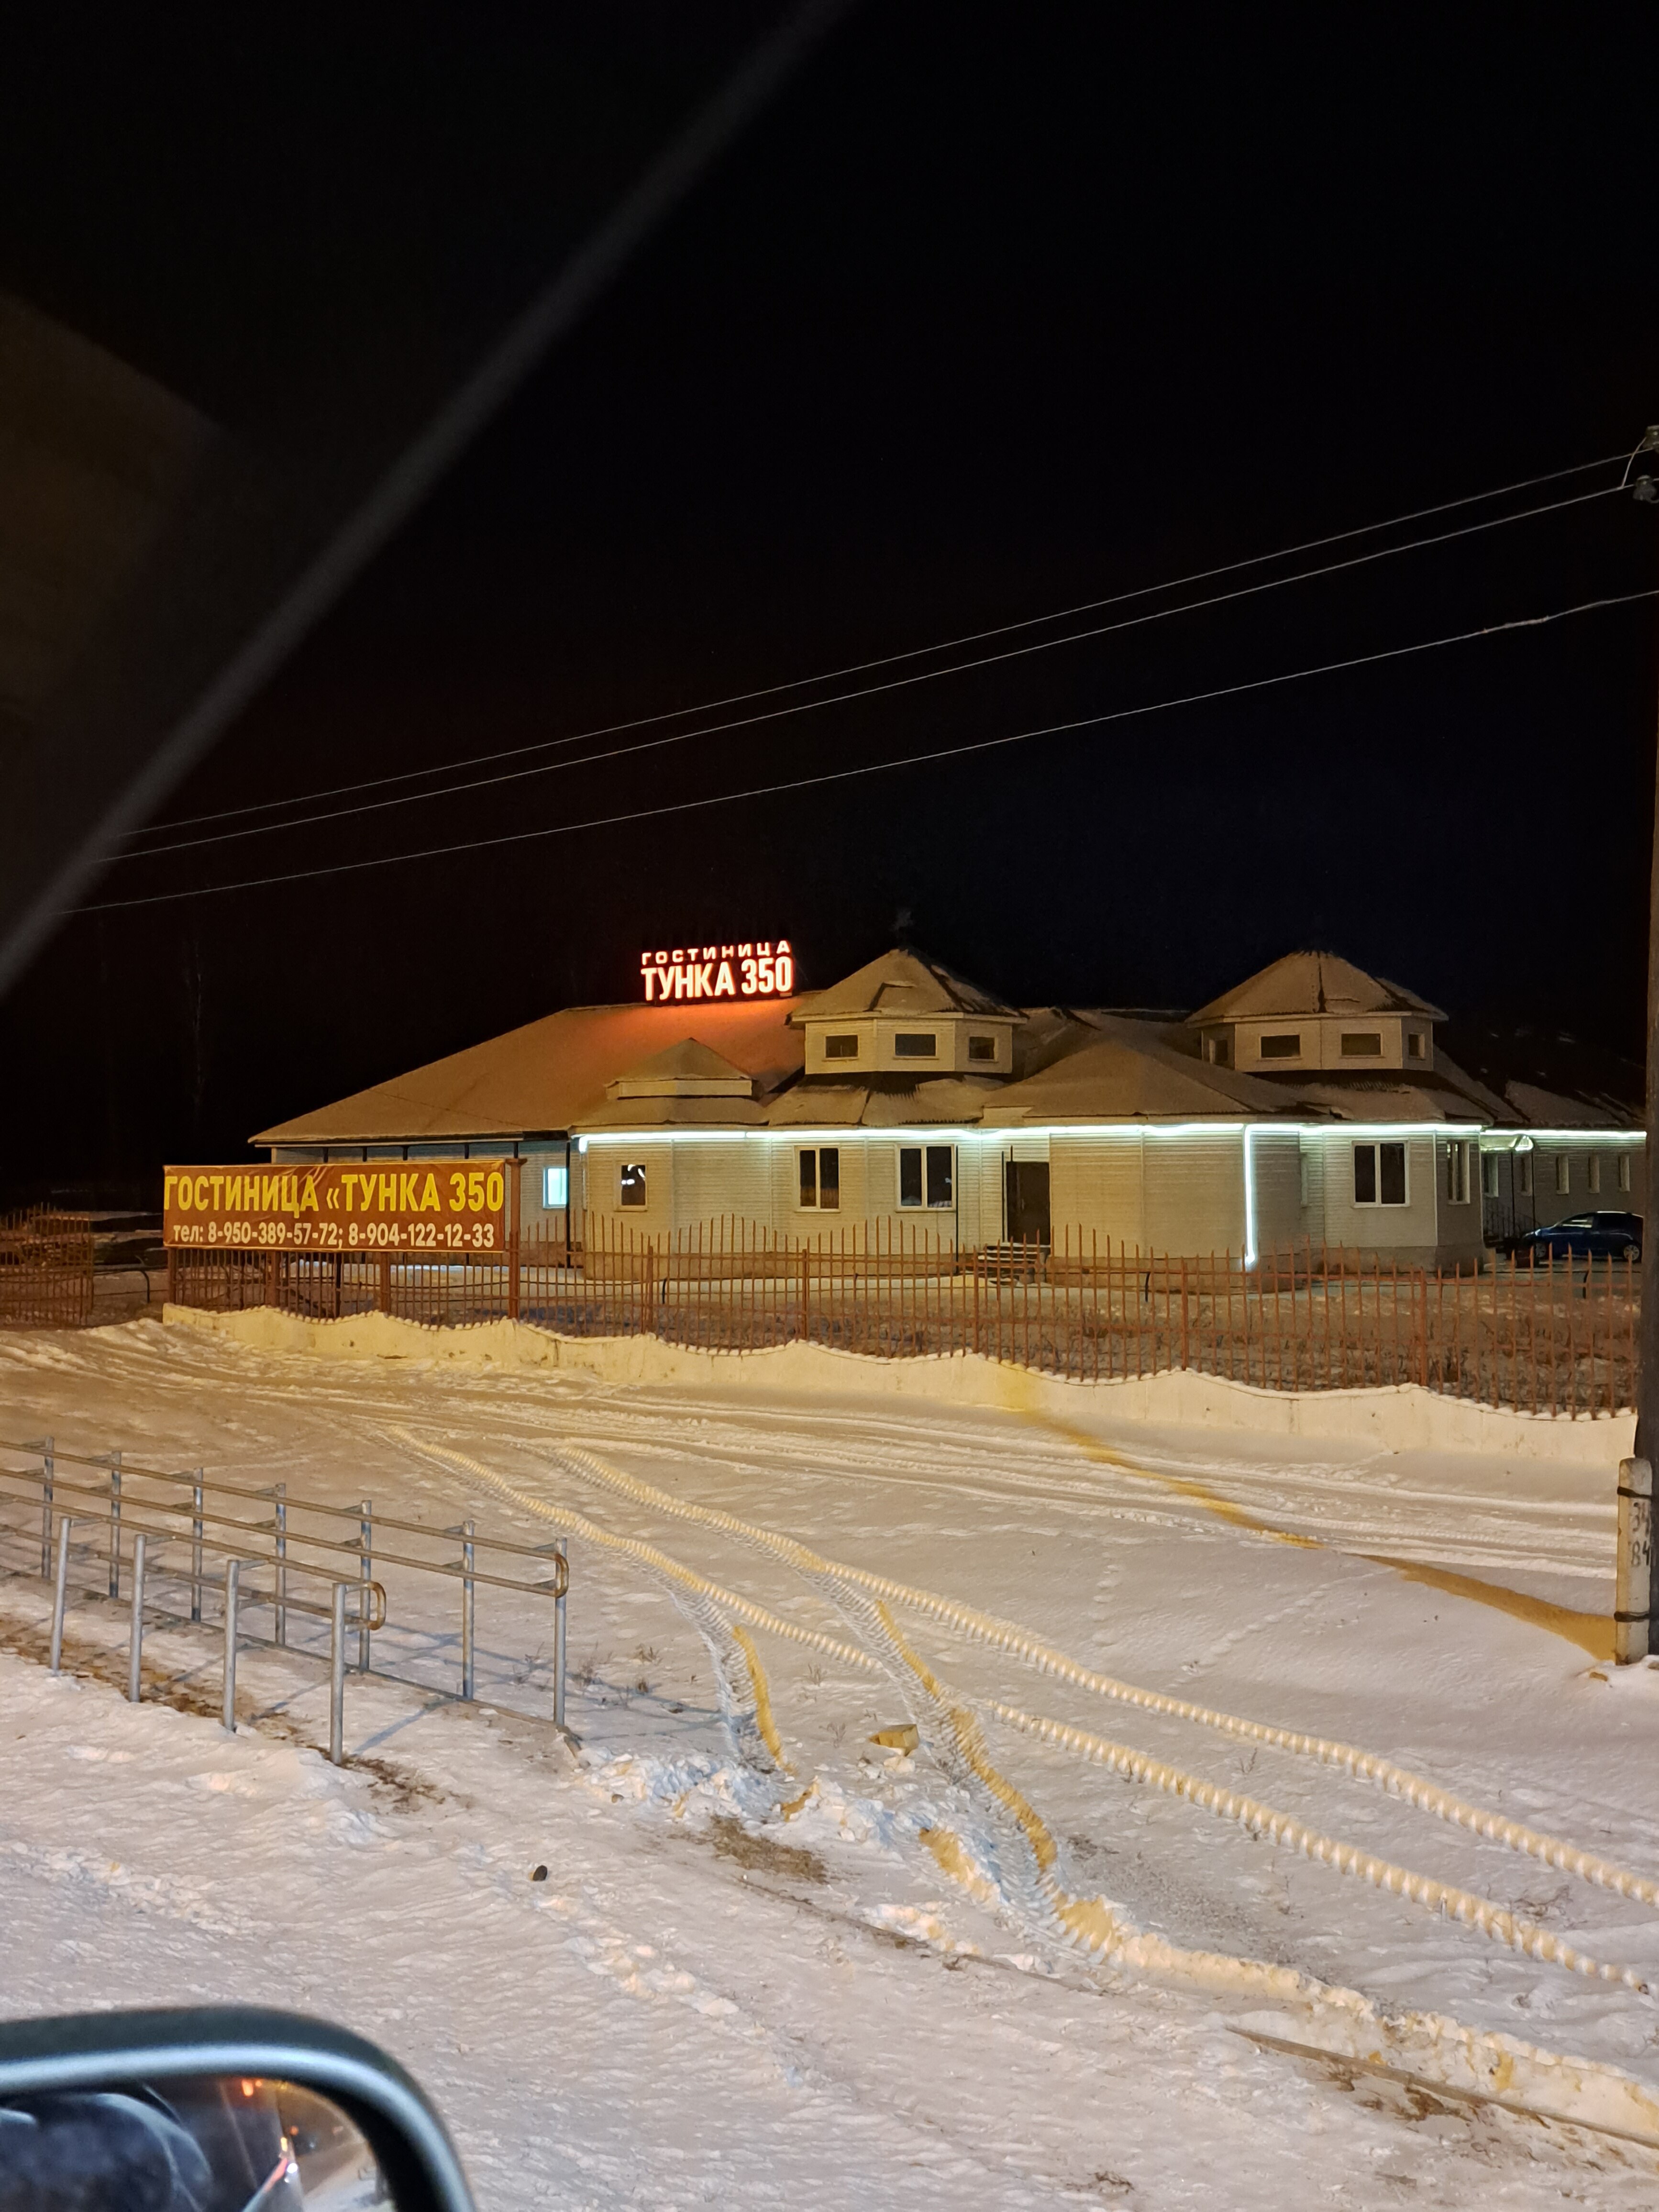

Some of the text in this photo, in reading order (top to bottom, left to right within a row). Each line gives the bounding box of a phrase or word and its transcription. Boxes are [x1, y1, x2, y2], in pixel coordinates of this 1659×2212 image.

[641, 940, 790, 965] ГОСТИНИЦА
[641, 956, 792, 1001] ТУНКА 350
[164, 1171, 504, 1218] ГОСТИНИЦА «ТУНКА 350
[173, 1221, 494, 1248] тел: 8-950-389-57-72; 8-904-122-12-33
